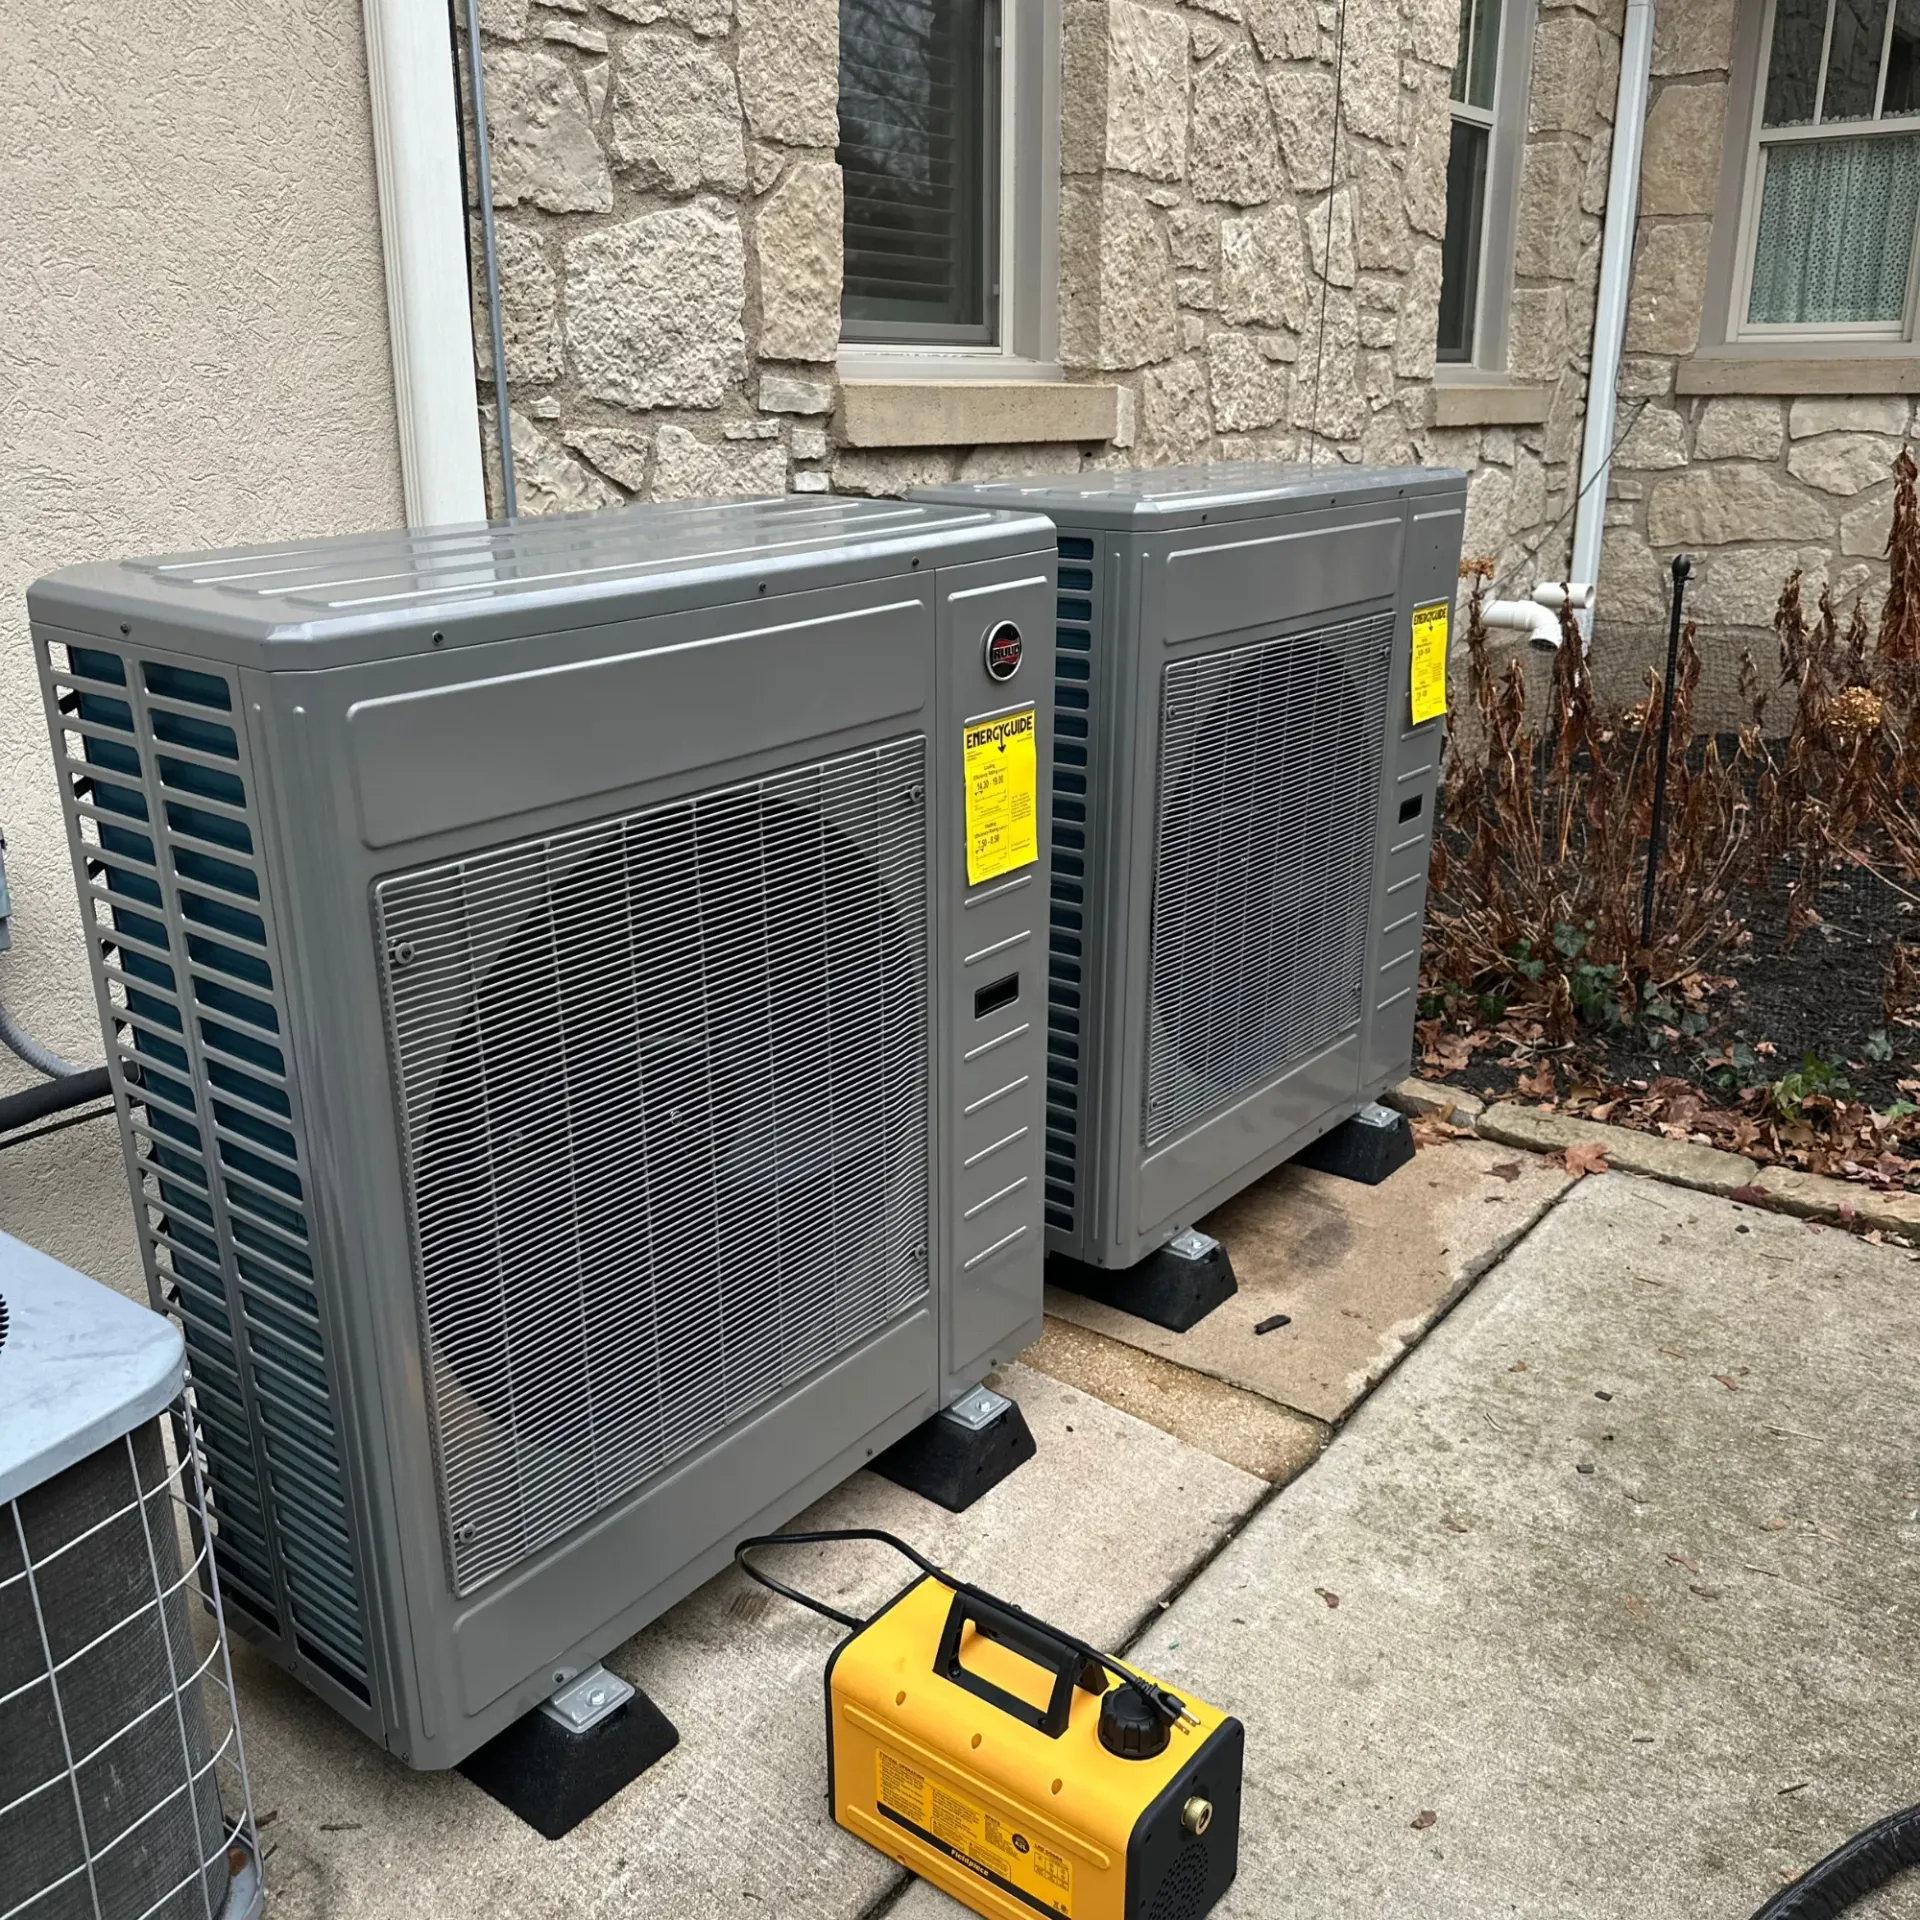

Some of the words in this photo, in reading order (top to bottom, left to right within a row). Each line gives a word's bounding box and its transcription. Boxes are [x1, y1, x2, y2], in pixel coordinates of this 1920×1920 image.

[993, 644, 1020, 661] RUUD
[966, 715, 1033, 751] ENERGYGUIDE
[950, 1848, 989, 1877] Fieldpiece
